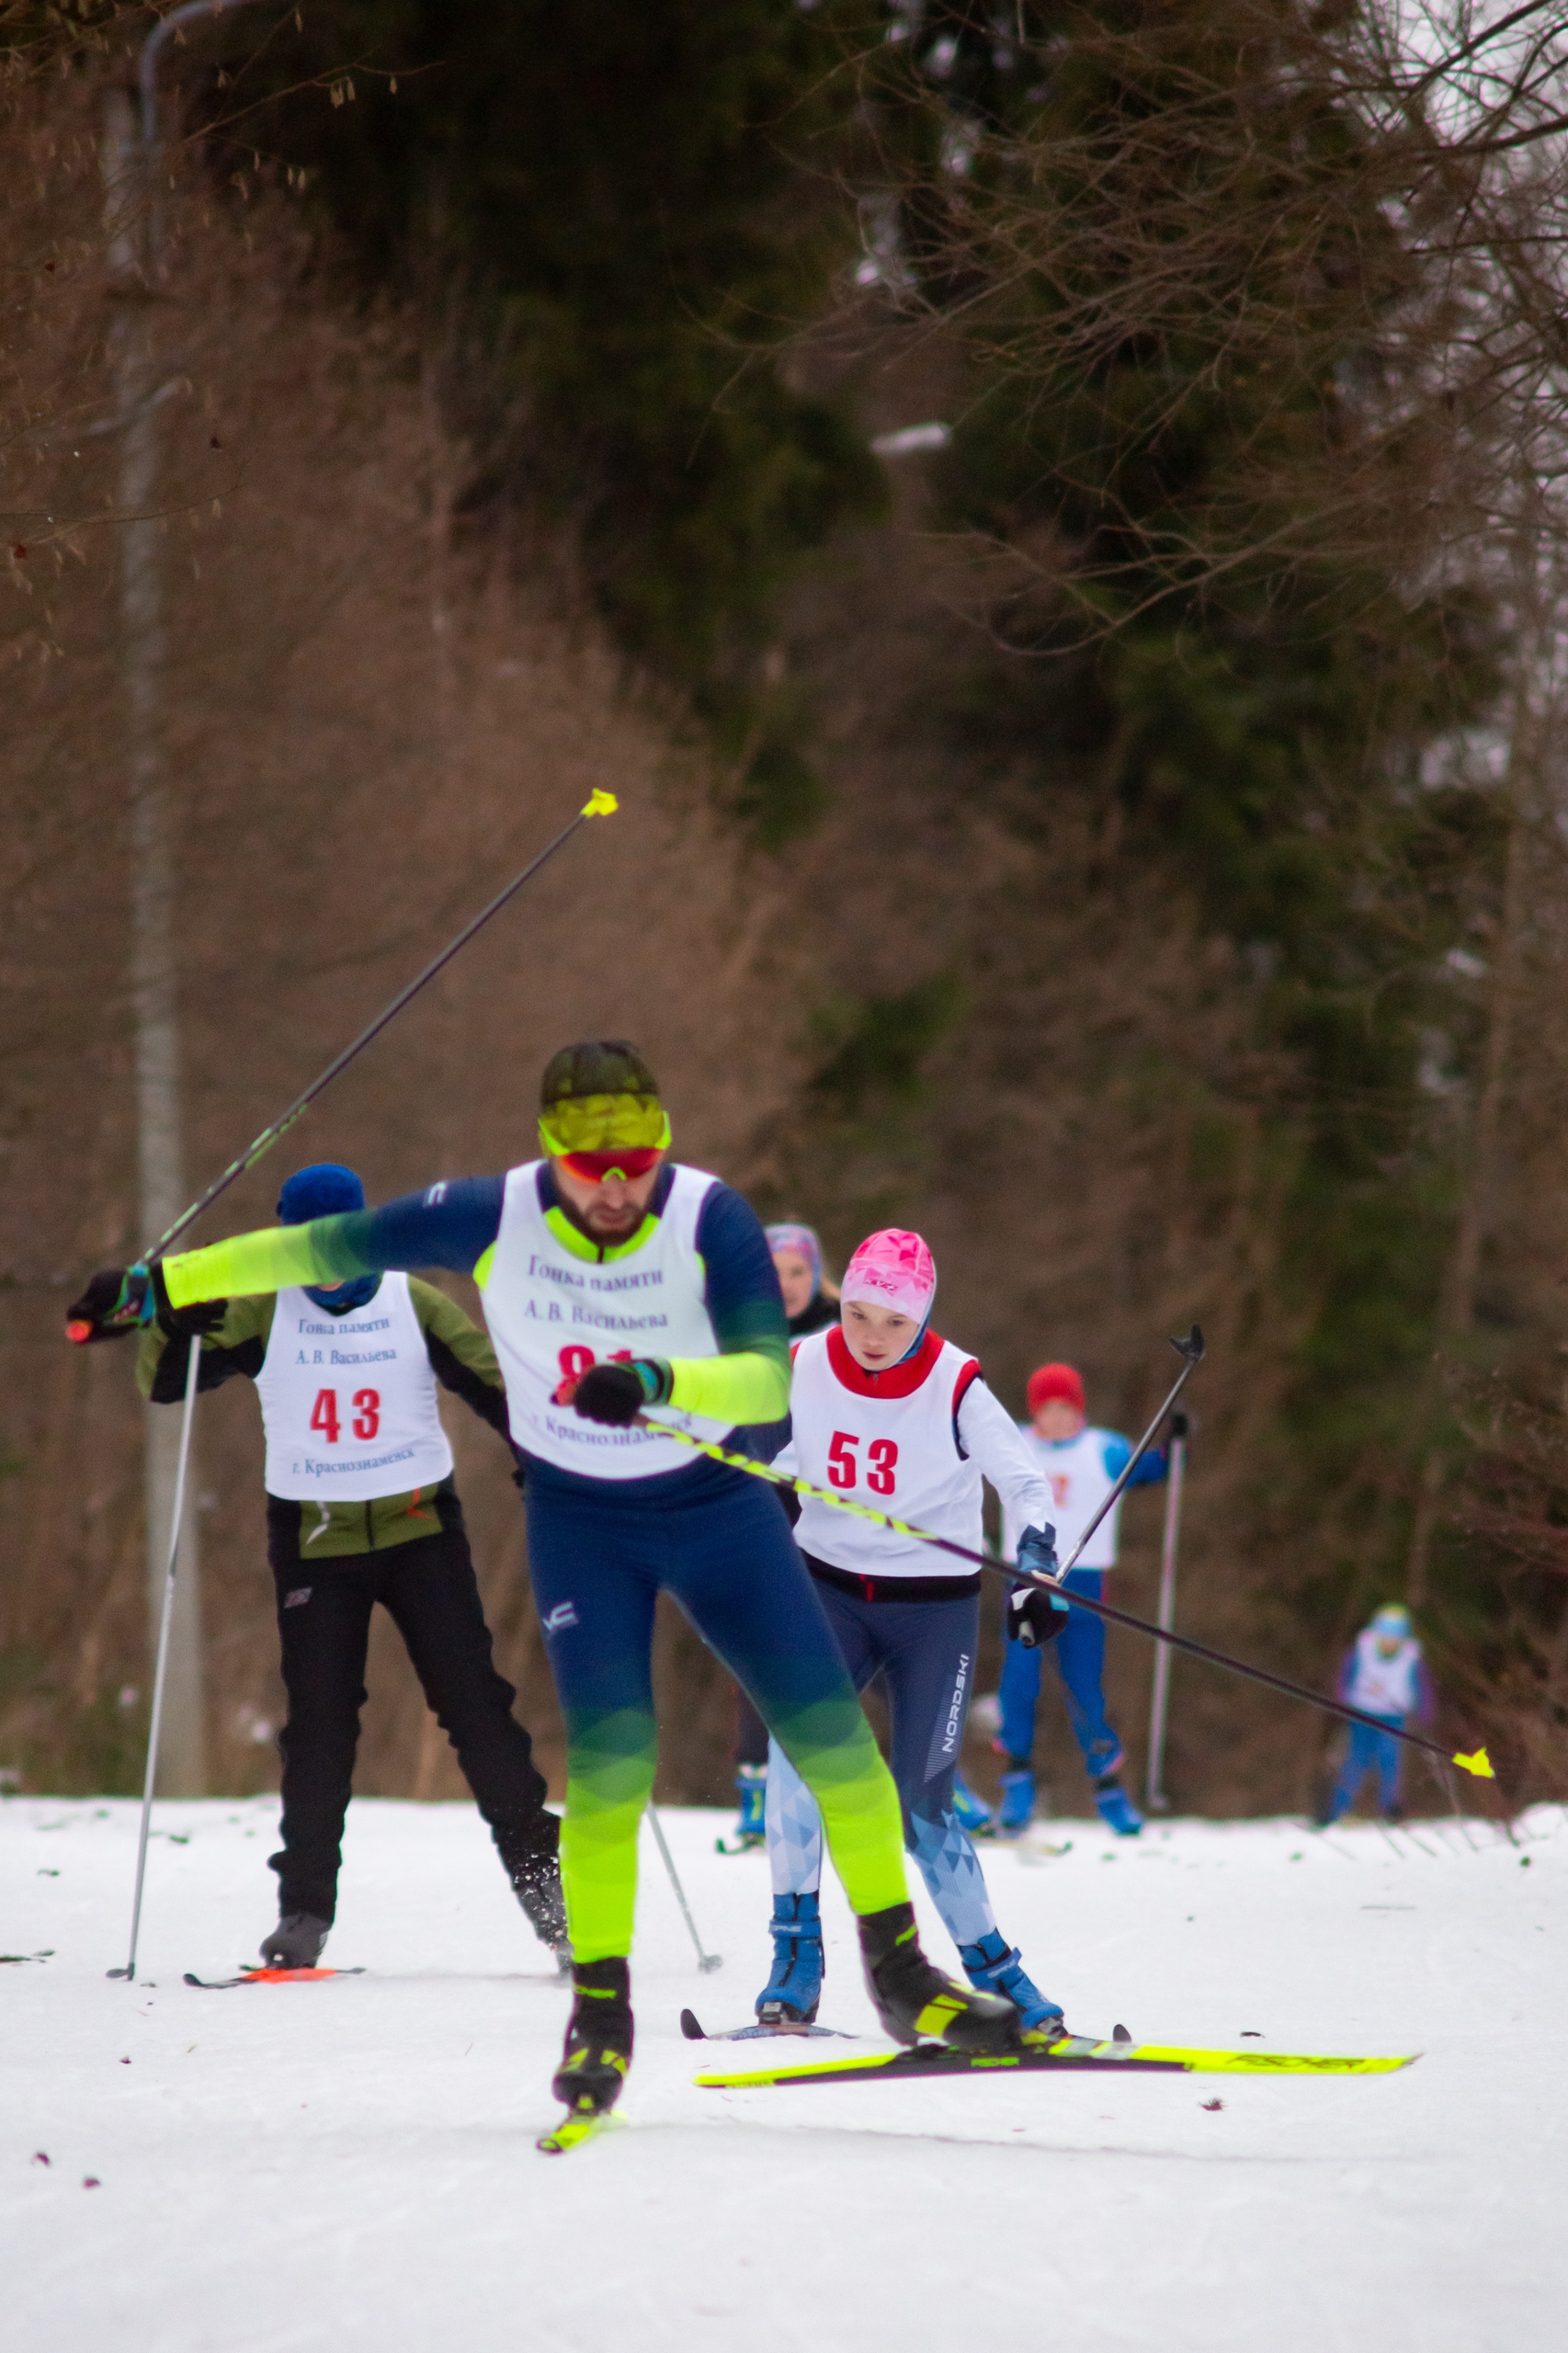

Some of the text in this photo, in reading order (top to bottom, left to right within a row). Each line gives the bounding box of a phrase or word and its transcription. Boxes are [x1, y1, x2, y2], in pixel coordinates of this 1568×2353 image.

[528, 1254, 663, 1291] Гонка памяти
[299, 1318, 390, 1336] Гонка памяти
[573, 1305, 668, 1330] Васильева
[330, 1348, 397, 1365] Васильева
[310, 1388, 381, 1444] 43
[305, 1448, 415, 1478] Краснознаменск
[827, 1429, 899, 1495] 53
[941, 1654, 970, 1753] NORDSKI
